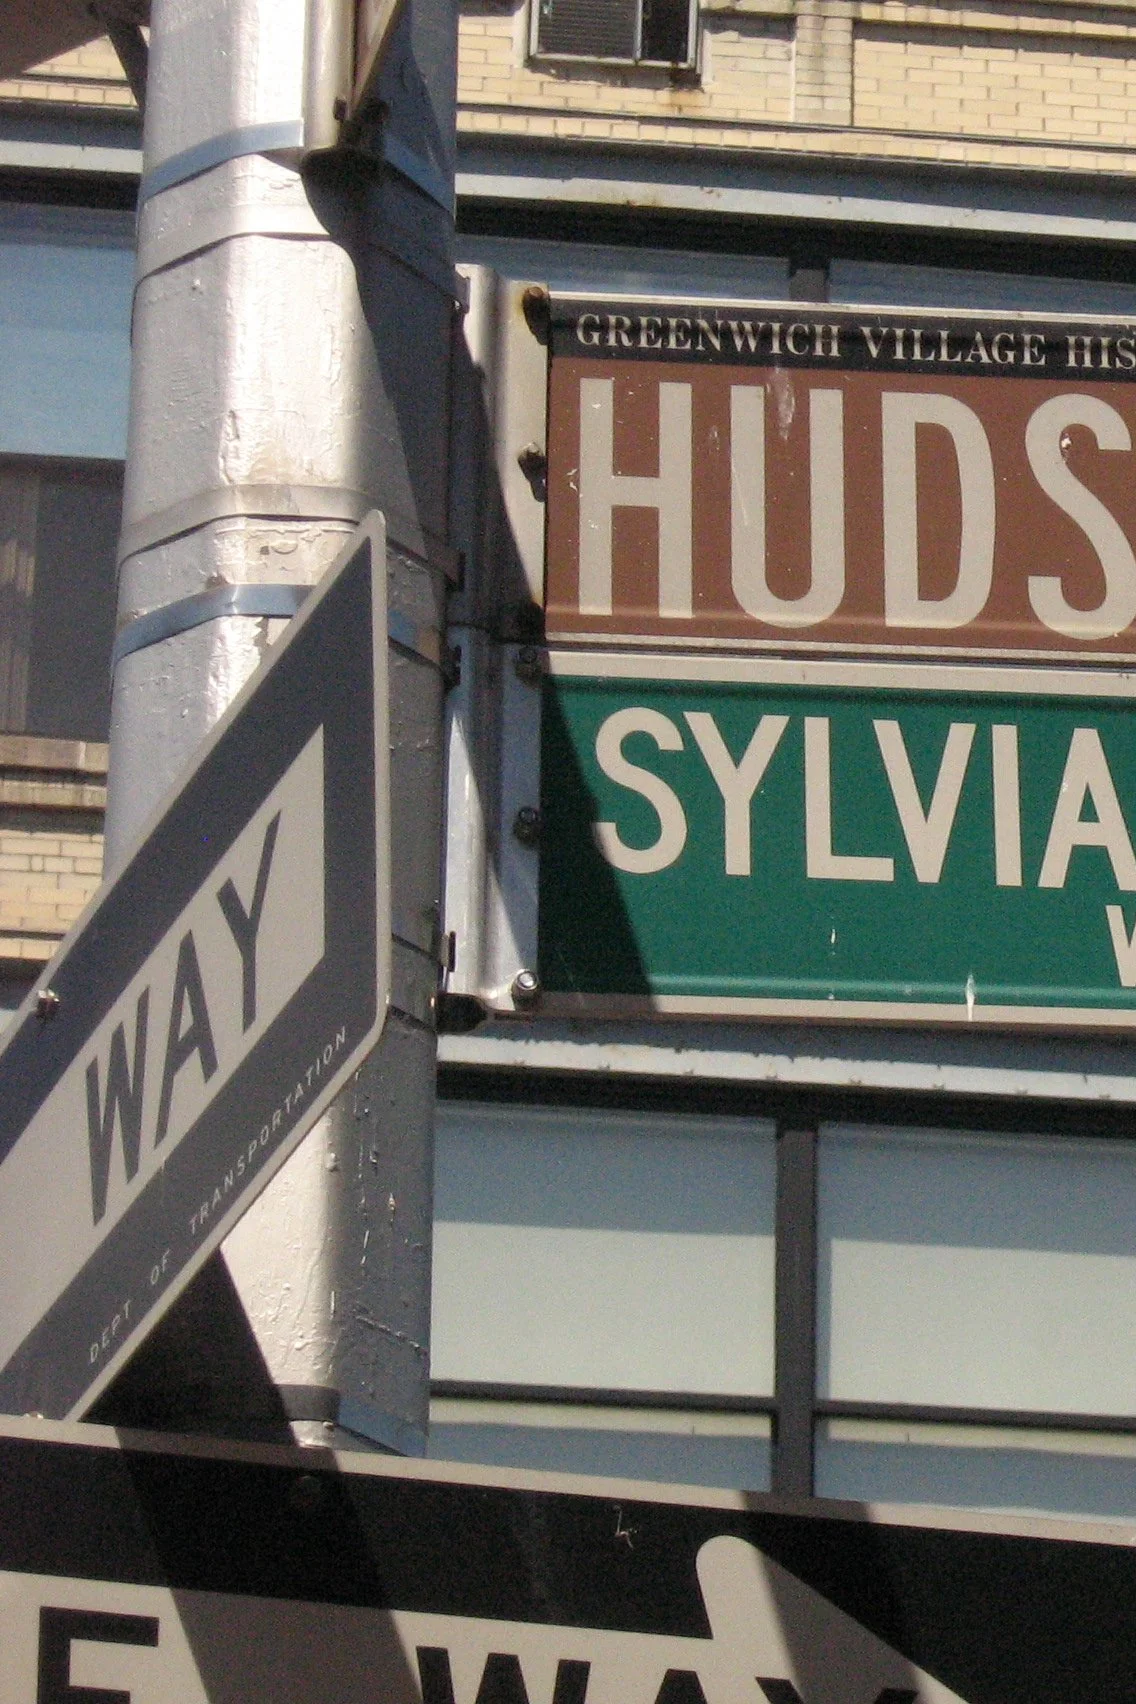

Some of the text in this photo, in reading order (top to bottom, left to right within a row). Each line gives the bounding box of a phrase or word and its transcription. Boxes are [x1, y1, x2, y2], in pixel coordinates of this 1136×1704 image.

[575, 313, 842, 357] GREENWICH
[859, 325, 1047, 366] VILLAGE
[85, 810, 282, 1227] WAY
[89, 1025, 348, 1364] DEPT OF TRANSPORTATION
